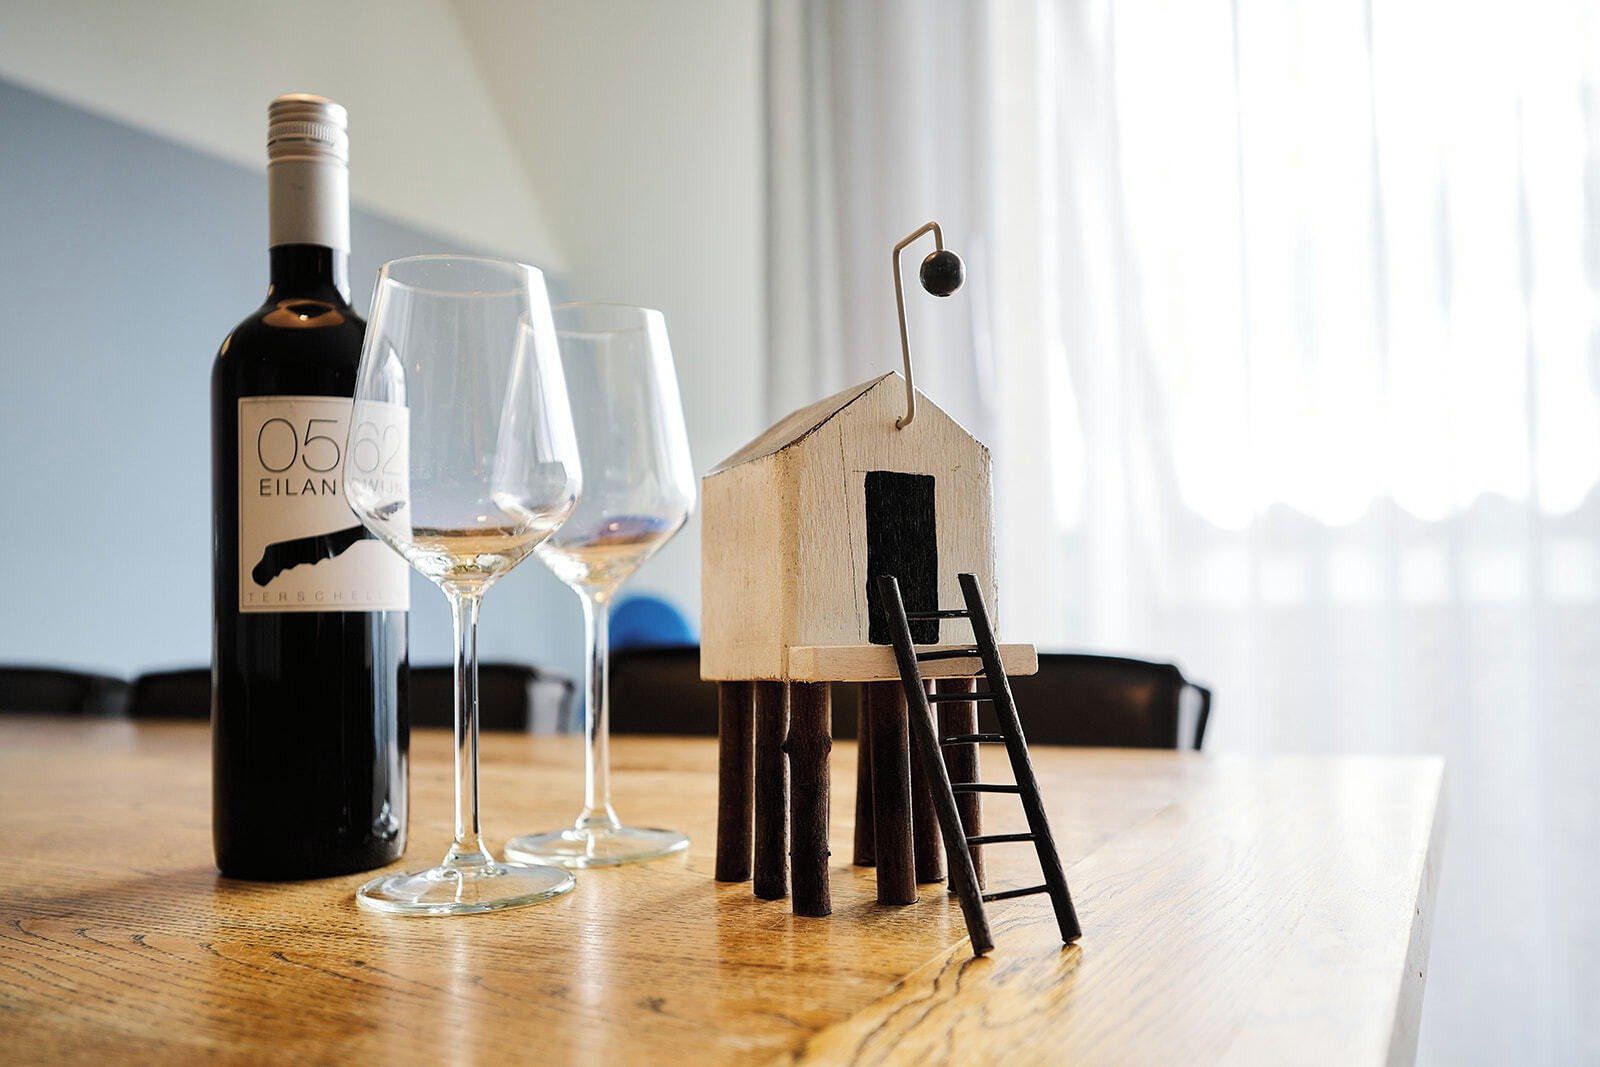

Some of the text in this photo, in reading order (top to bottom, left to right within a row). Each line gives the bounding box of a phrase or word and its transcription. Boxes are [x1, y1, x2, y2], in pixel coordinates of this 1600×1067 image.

[257, 417, 401, 475] 0562
[259, 477, 402, 497] EILANWIJN
[247, 590, 398, 602] TERSCHELL
